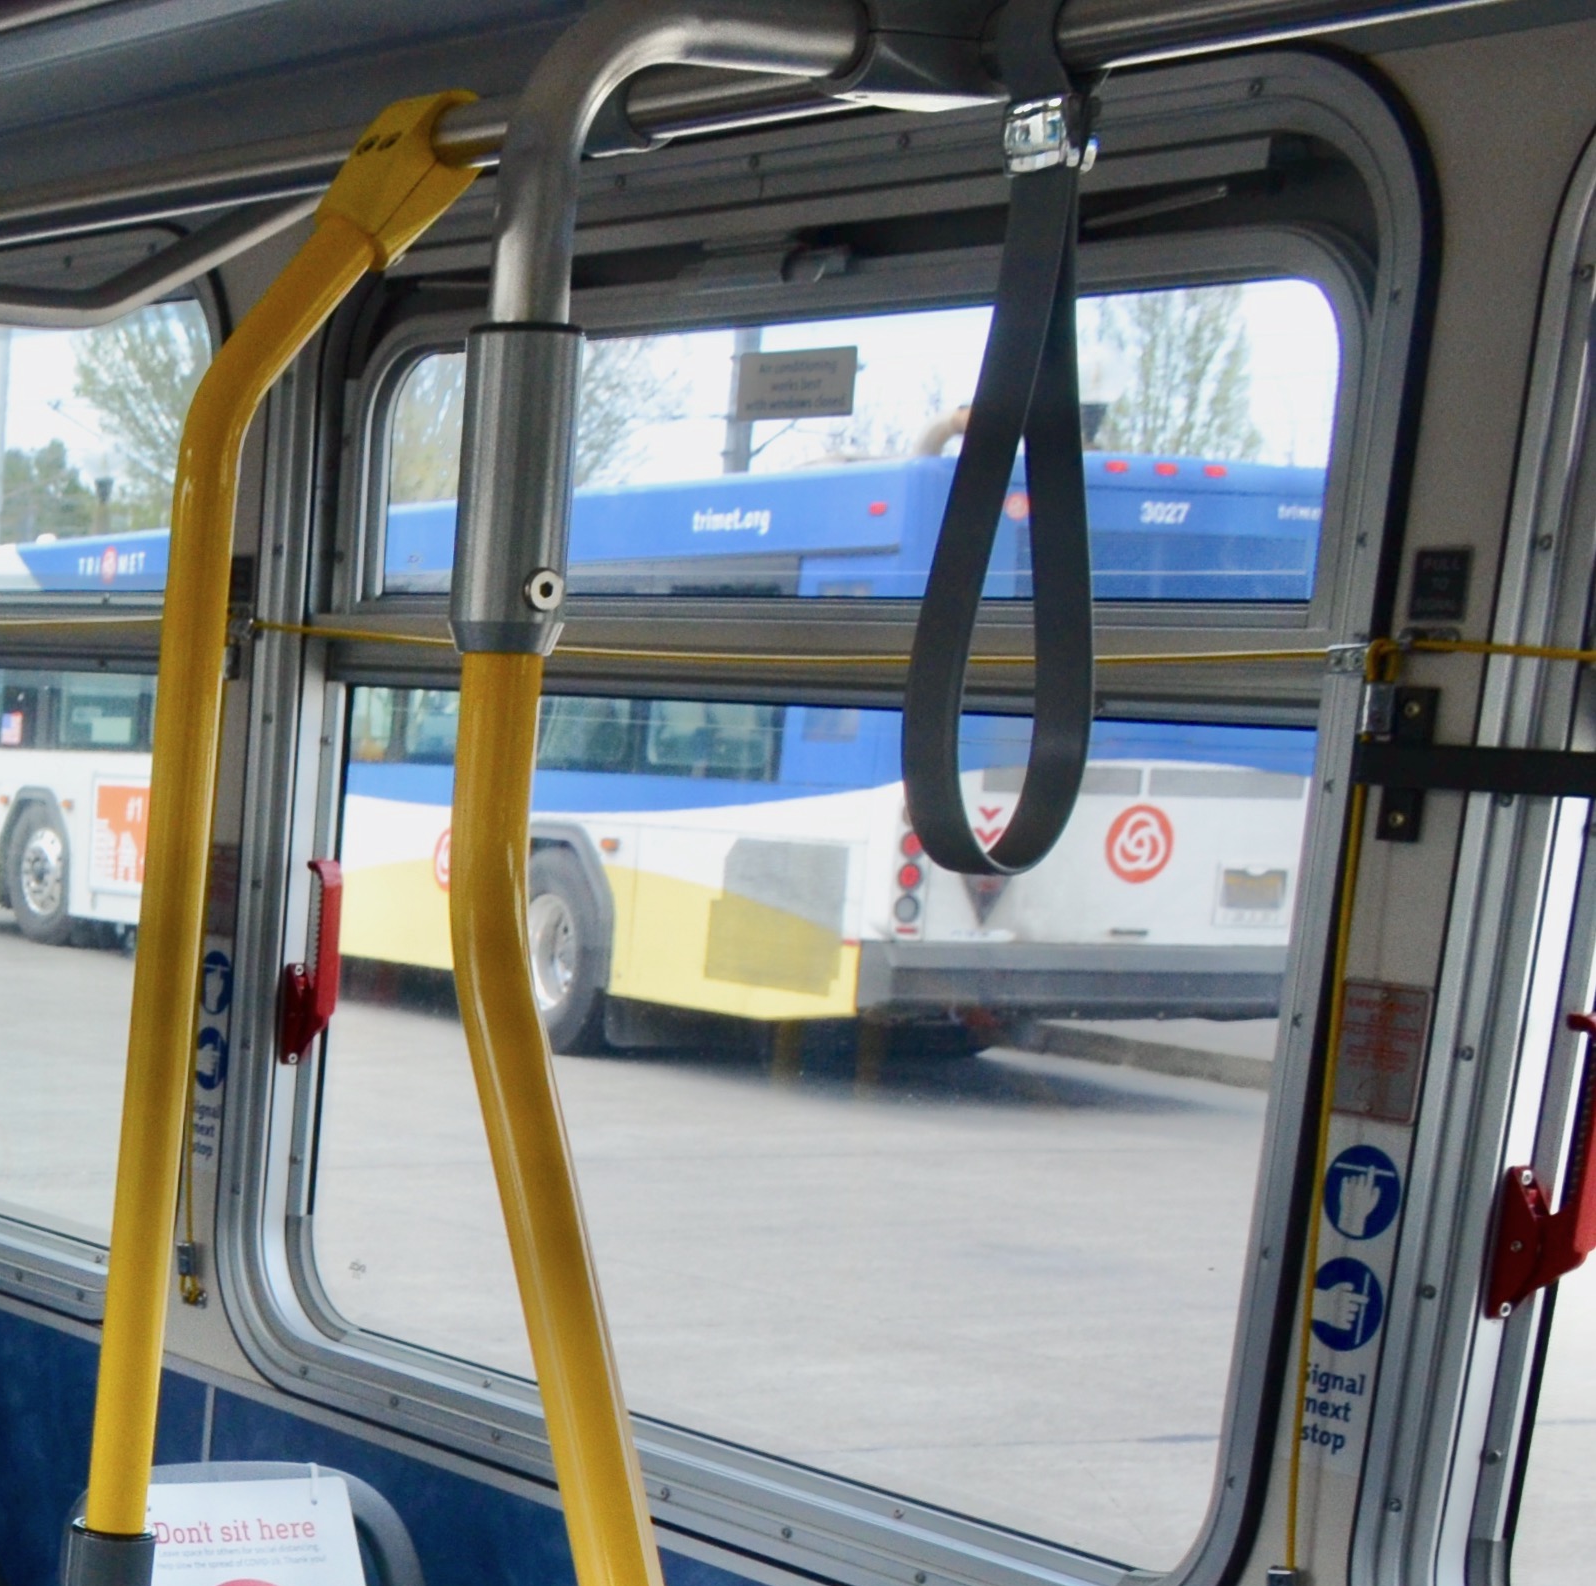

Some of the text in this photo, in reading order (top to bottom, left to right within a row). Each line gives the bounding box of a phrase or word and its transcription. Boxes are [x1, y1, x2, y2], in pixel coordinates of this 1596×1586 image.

[692, 507, 771, 536] trimet.org
[1140, 501, 1191, 524] 3027
[1305, 1396, 1352, 1422] next
[1301, 1423, 1346, 1455] stop
[220, 1517, 253, 1543] sit
[256, 1516, 316, 1541] here
